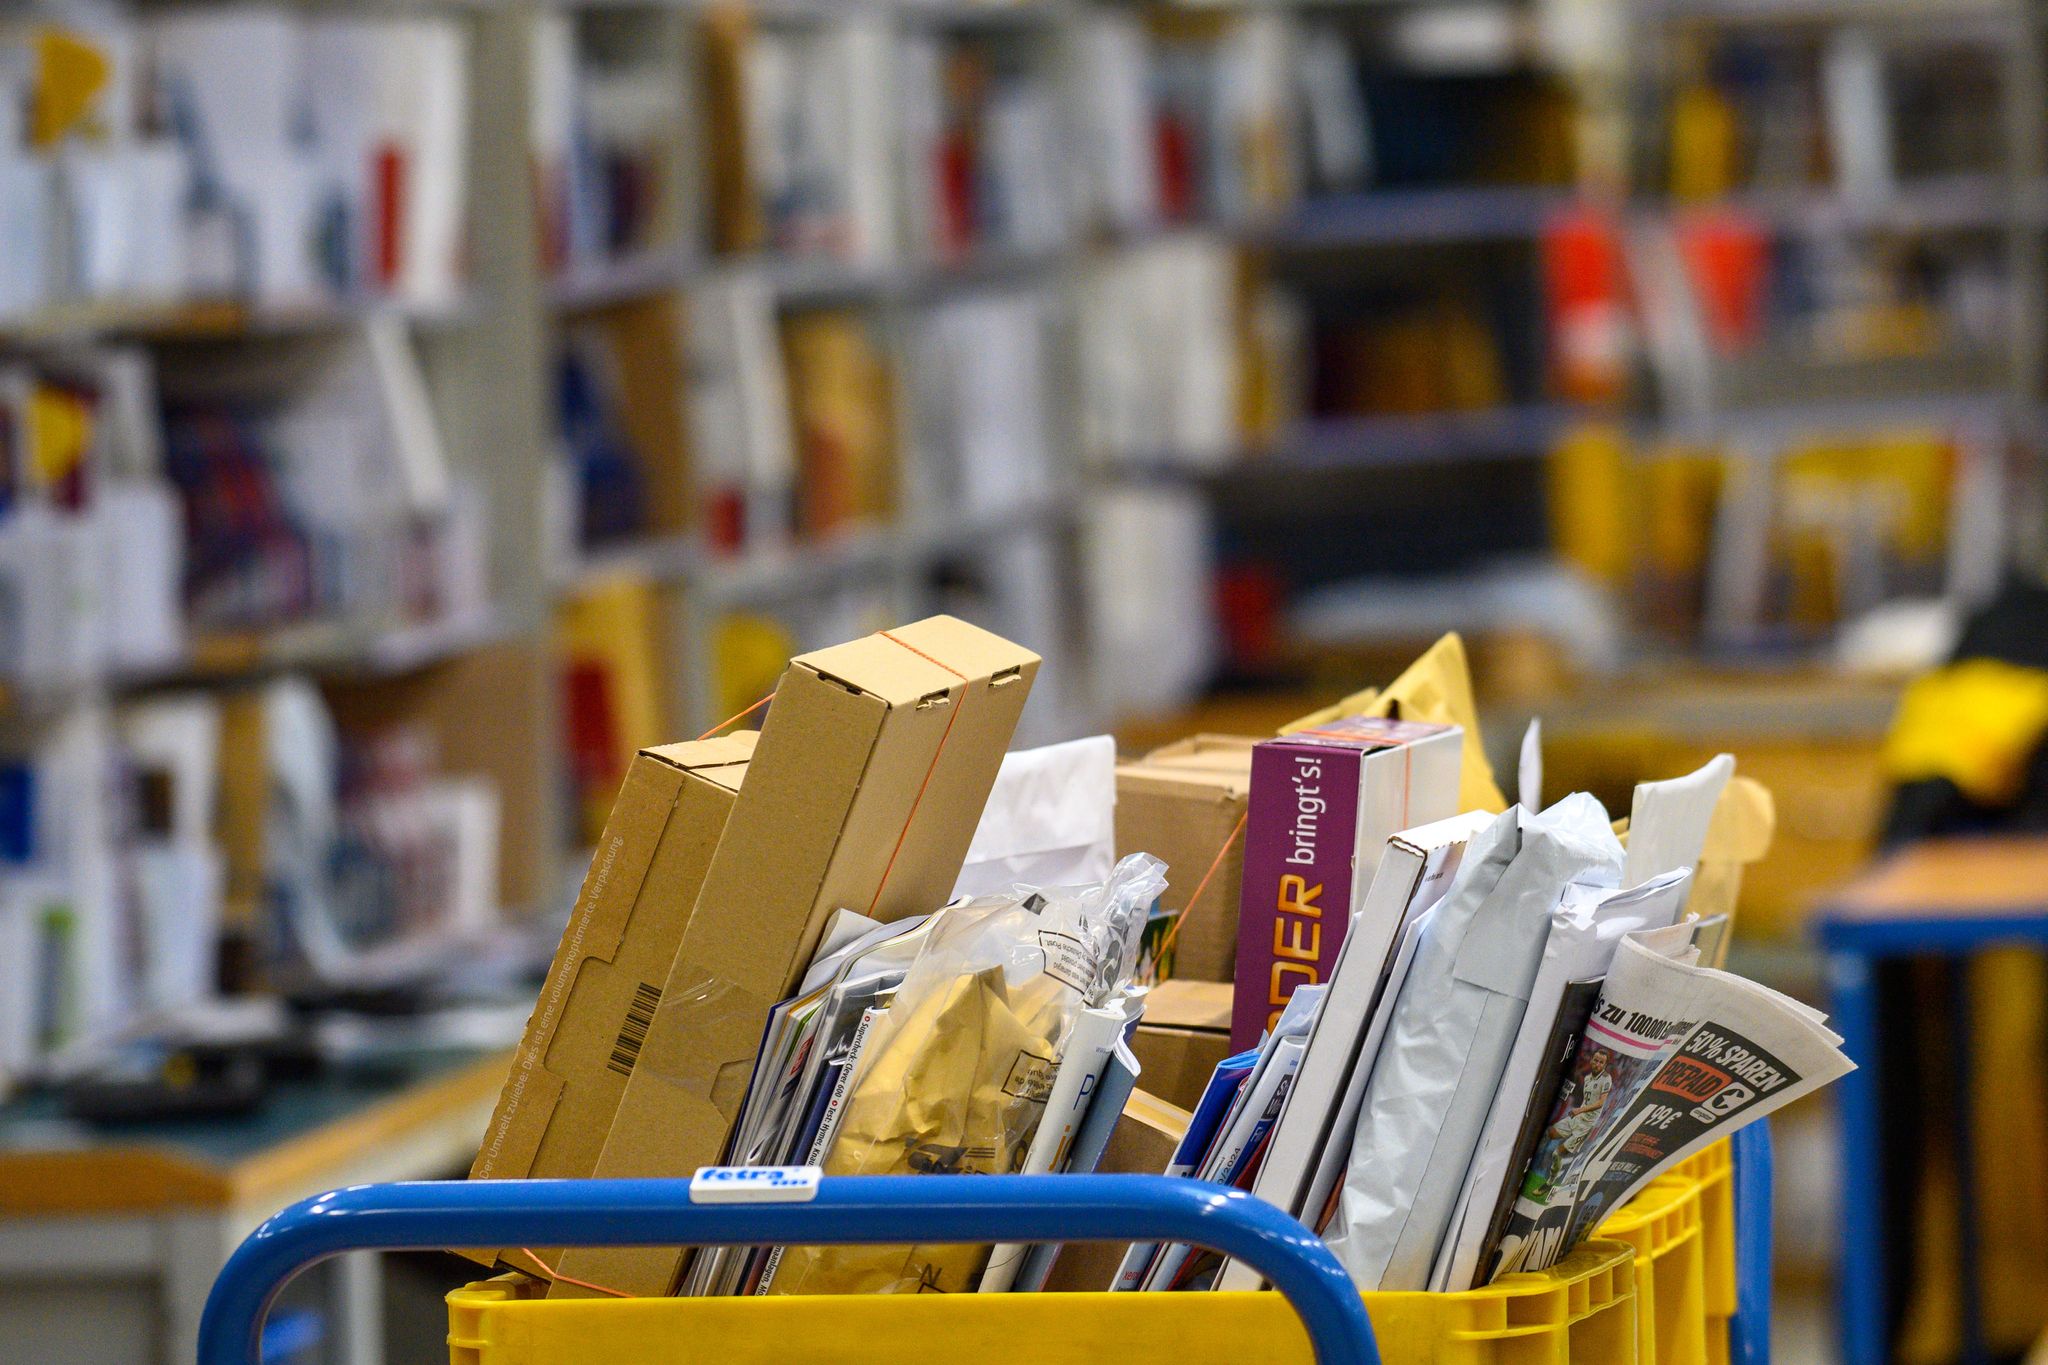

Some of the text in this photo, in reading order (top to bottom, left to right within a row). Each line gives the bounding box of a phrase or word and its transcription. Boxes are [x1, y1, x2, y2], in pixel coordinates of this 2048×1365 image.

[1600, 1004, 1627, 1025] zu
[480, 1159, 494, 1178] Der
[489, 1114, 511, 1157] Umwelt
[506, 1071, 527, 1114] zuliebe:
[521, 1044, 539, 1070] Dies
[535, 1030, 545, 1045] ist
[540, 1004, 555, 1028] eine
[552, 902, 595, 1004] volumenoptimierte
[846, 1022, 869, 1063] Supercheck:
[1686, 1030, 1724, 1062] 50%
[1720, 1044, 1788, 1092] SPAREN
[839, 1062, 853, 1085] Clever
[1663, 1063, 1720, 1097] PREPAID
[833, 1083, 845, 1097] 600
[823, 1106, 836, 1123] Test:
[806, 1147, 819, 1168] Knau
